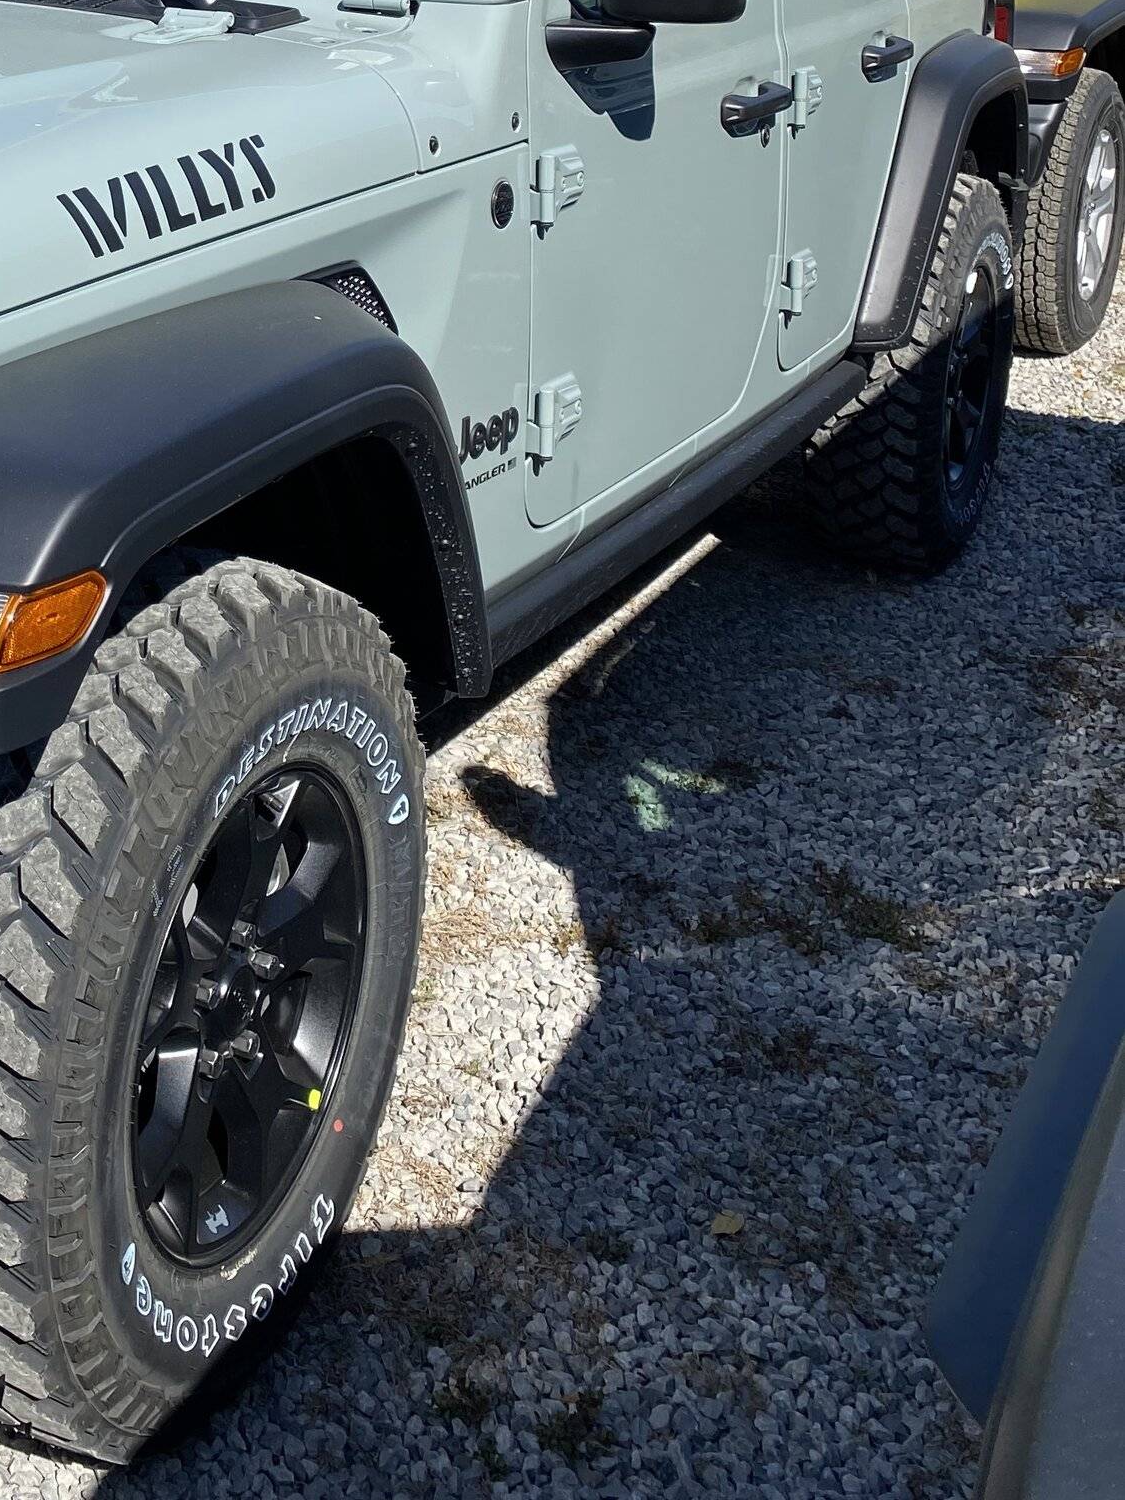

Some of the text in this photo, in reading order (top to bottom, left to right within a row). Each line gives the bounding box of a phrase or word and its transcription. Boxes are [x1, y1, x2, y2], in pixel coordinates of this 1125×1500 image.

[56, 134, 276, 258] WILLYS
[459, 406, 519, 466] Jeep
[465, 462, 506, 490] ANGLER
[214, 698, 402, 818] DESTINATION
